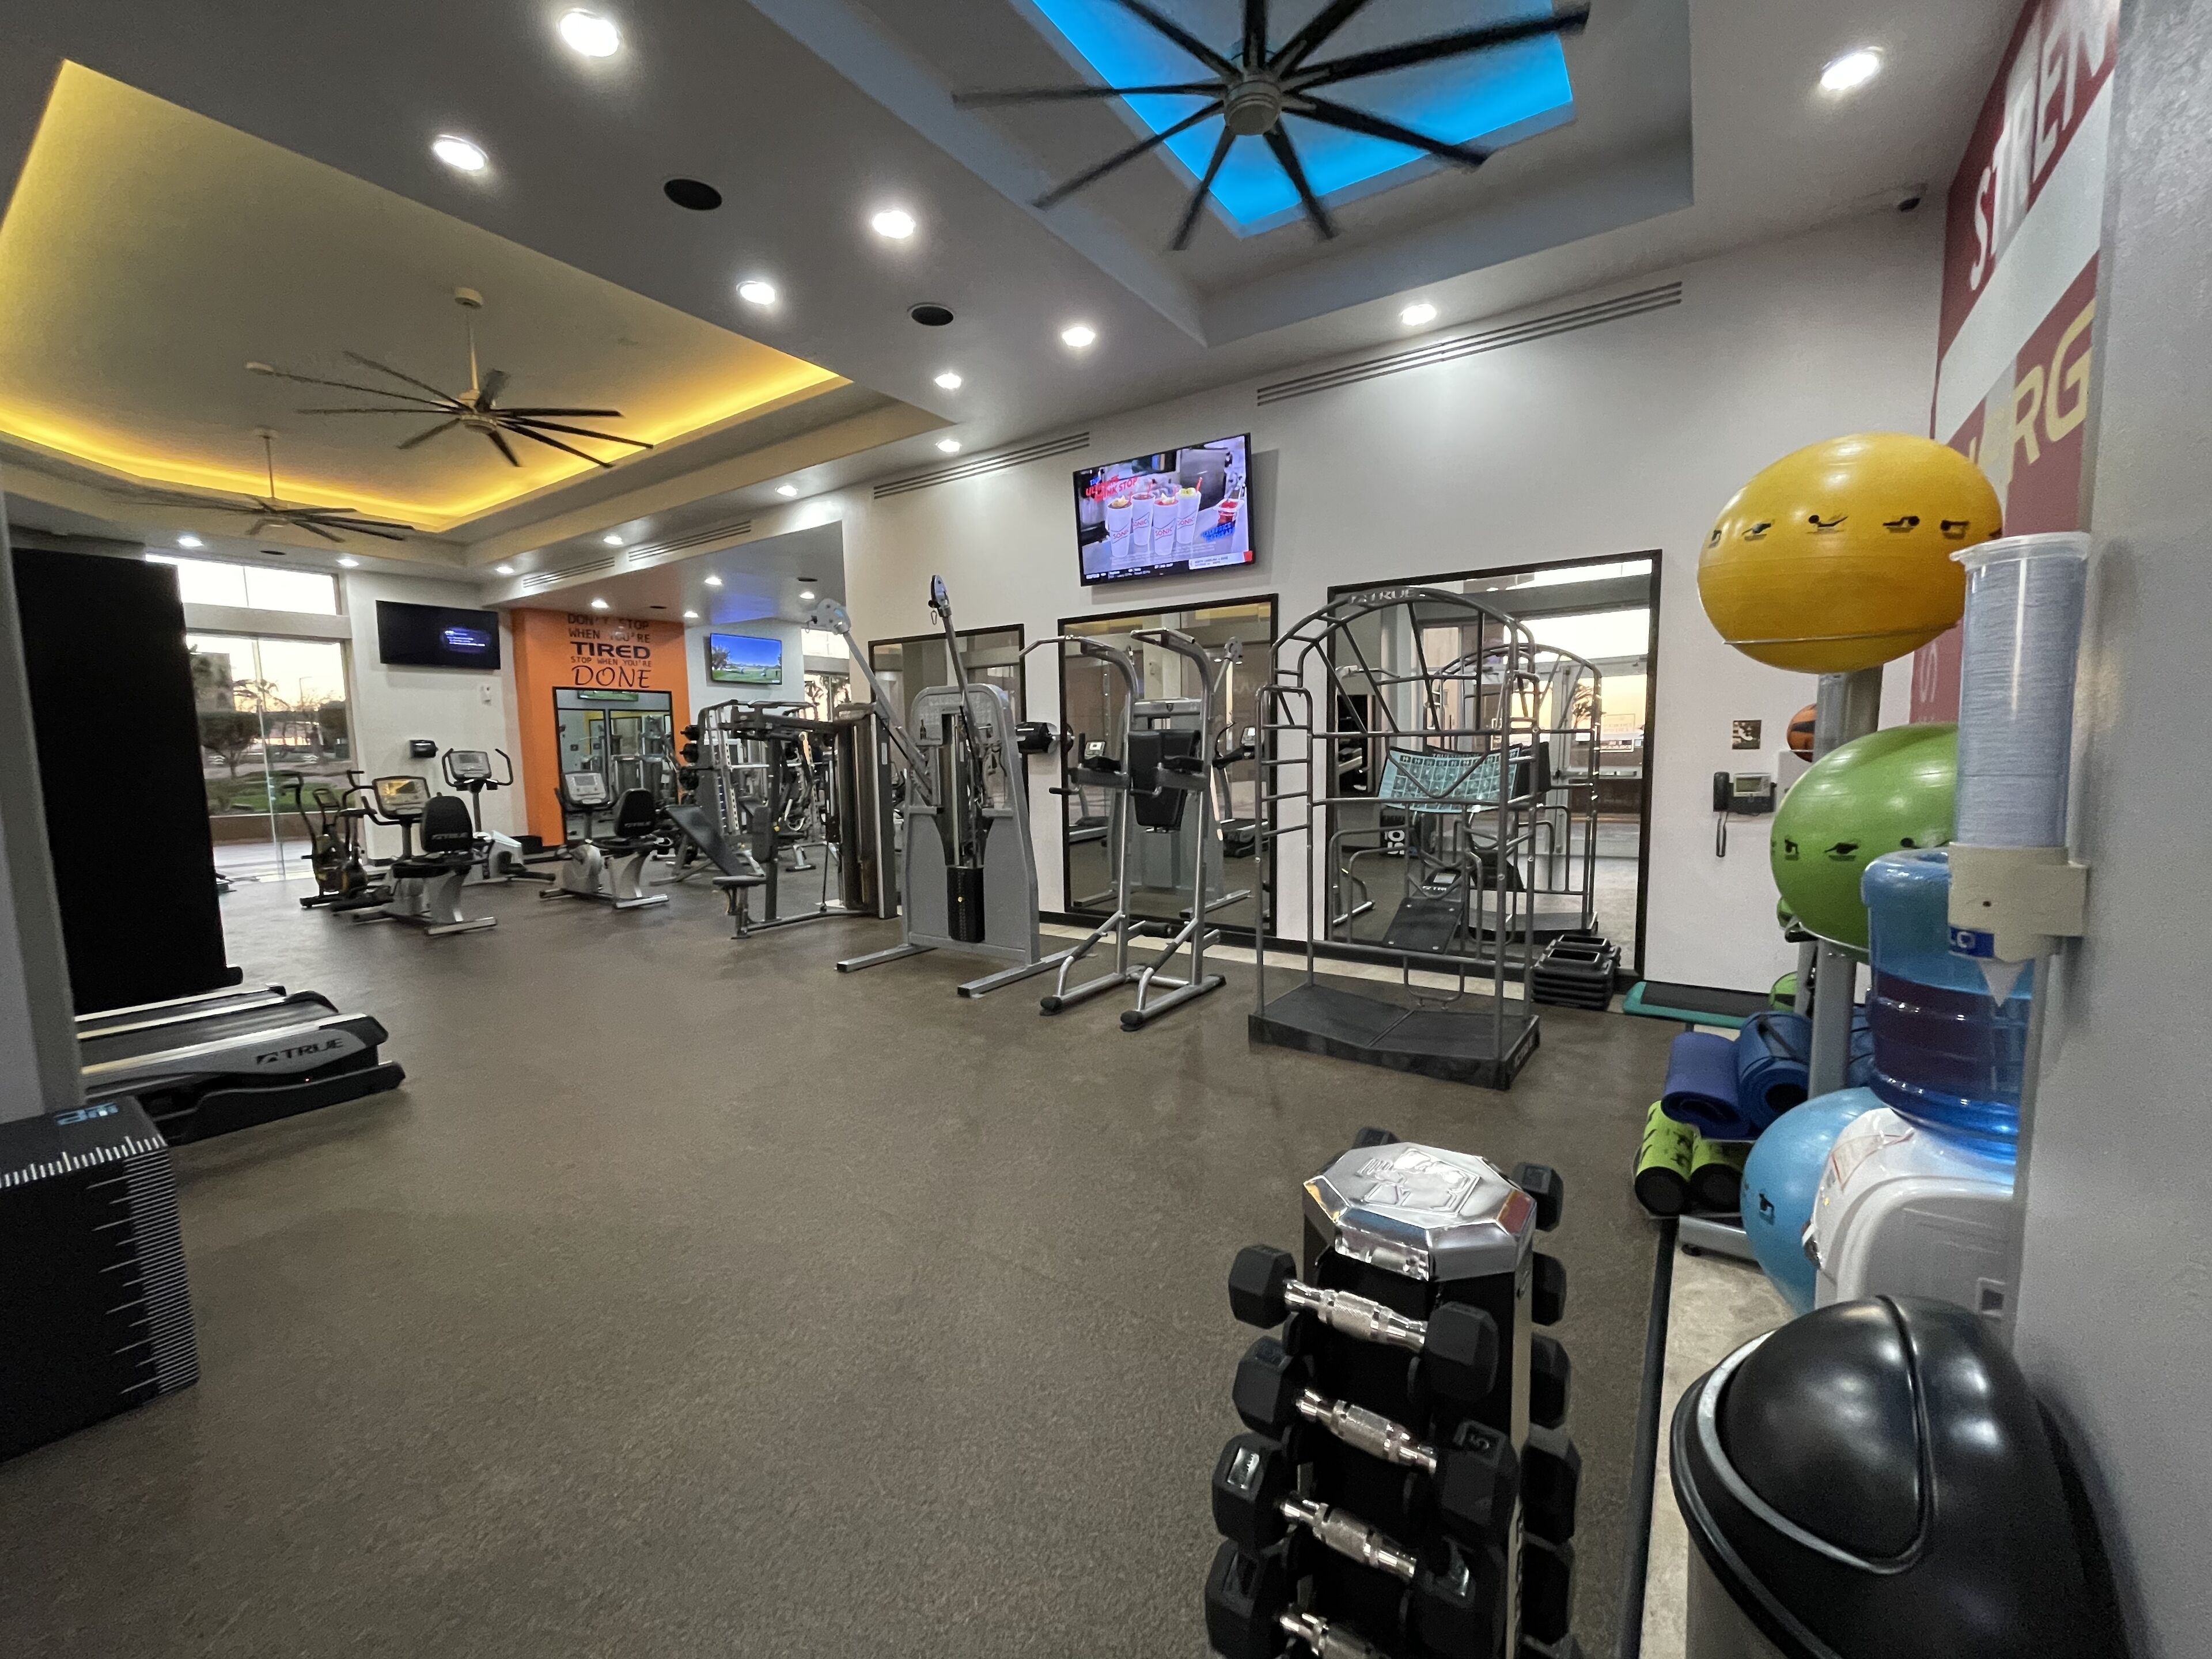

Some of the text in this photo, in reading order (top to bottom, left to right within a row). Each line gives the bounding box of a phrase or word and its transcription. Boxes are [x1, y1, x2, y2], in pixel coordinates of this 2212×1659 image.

[1367, 588, 1415, 602] TRUE
[568, 613, 649, 630] DON'T STOP
[569, 628, 650, 643] WHEN YOU'RE
[570, 641, 651, 660] TIRED
[570, 656, 652, 668] STOP WHEN YOU'RE
[571, 665, 652, 688] DONE
[279, 1037, 344, 1059] TRUE
